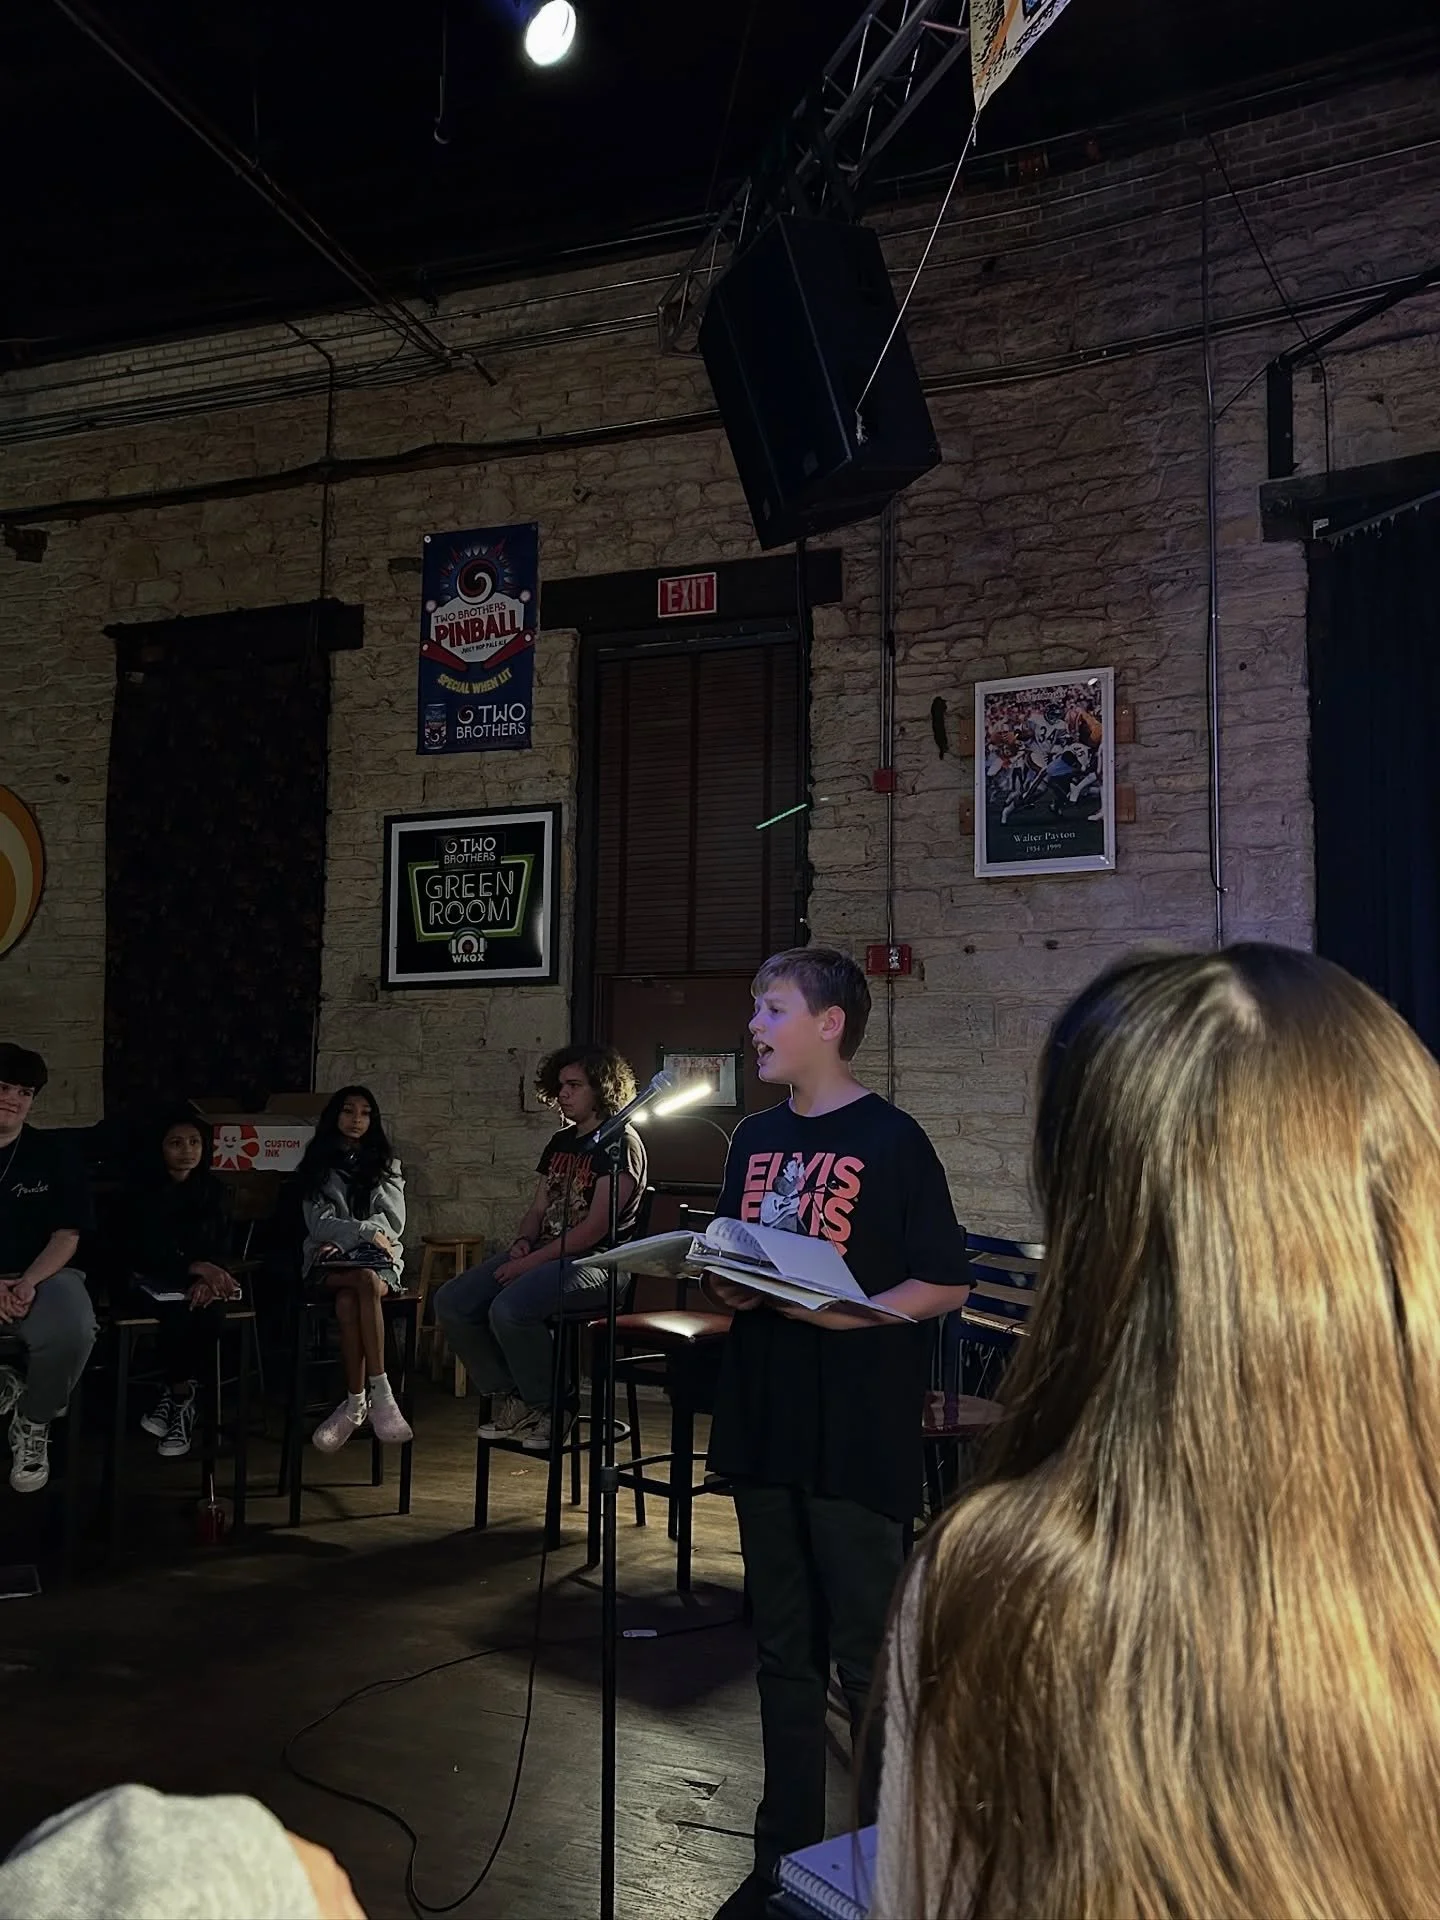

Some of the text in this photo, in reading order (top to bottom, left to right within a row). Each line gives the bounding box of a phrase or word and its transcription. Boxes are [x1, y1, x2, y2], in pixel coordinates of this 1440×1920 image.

[667, 577, 709, 612] EXIT
[434, 602, 506, 624] TWO BROTHERS
[434, 610, 520, 648] PINBALL
[485, 641, 498, 649] PALE
[437, 667, 512, 695] SPECIAL WHEN LIT
[478, 703, 526, 723] TWO
[456, 722, 526, 739] BROTHERS
[1039, 726, 1057, 745] 34
[460, 837, 496, 853] TWO
[1013, 831, 1076, 842] Walter Payton
[444, 852, 496, 864] BROTHERS
[425, 870, 514, 899] GREEN
[429, 896, 510, 925] ROOM
[452, 953, 485, 963] WKQX
[264, 1139, 300, 1148] CUSTOM
[265, 1149, 280, 1157] INK
[744, 1152, 865, 1199] ELVIS
